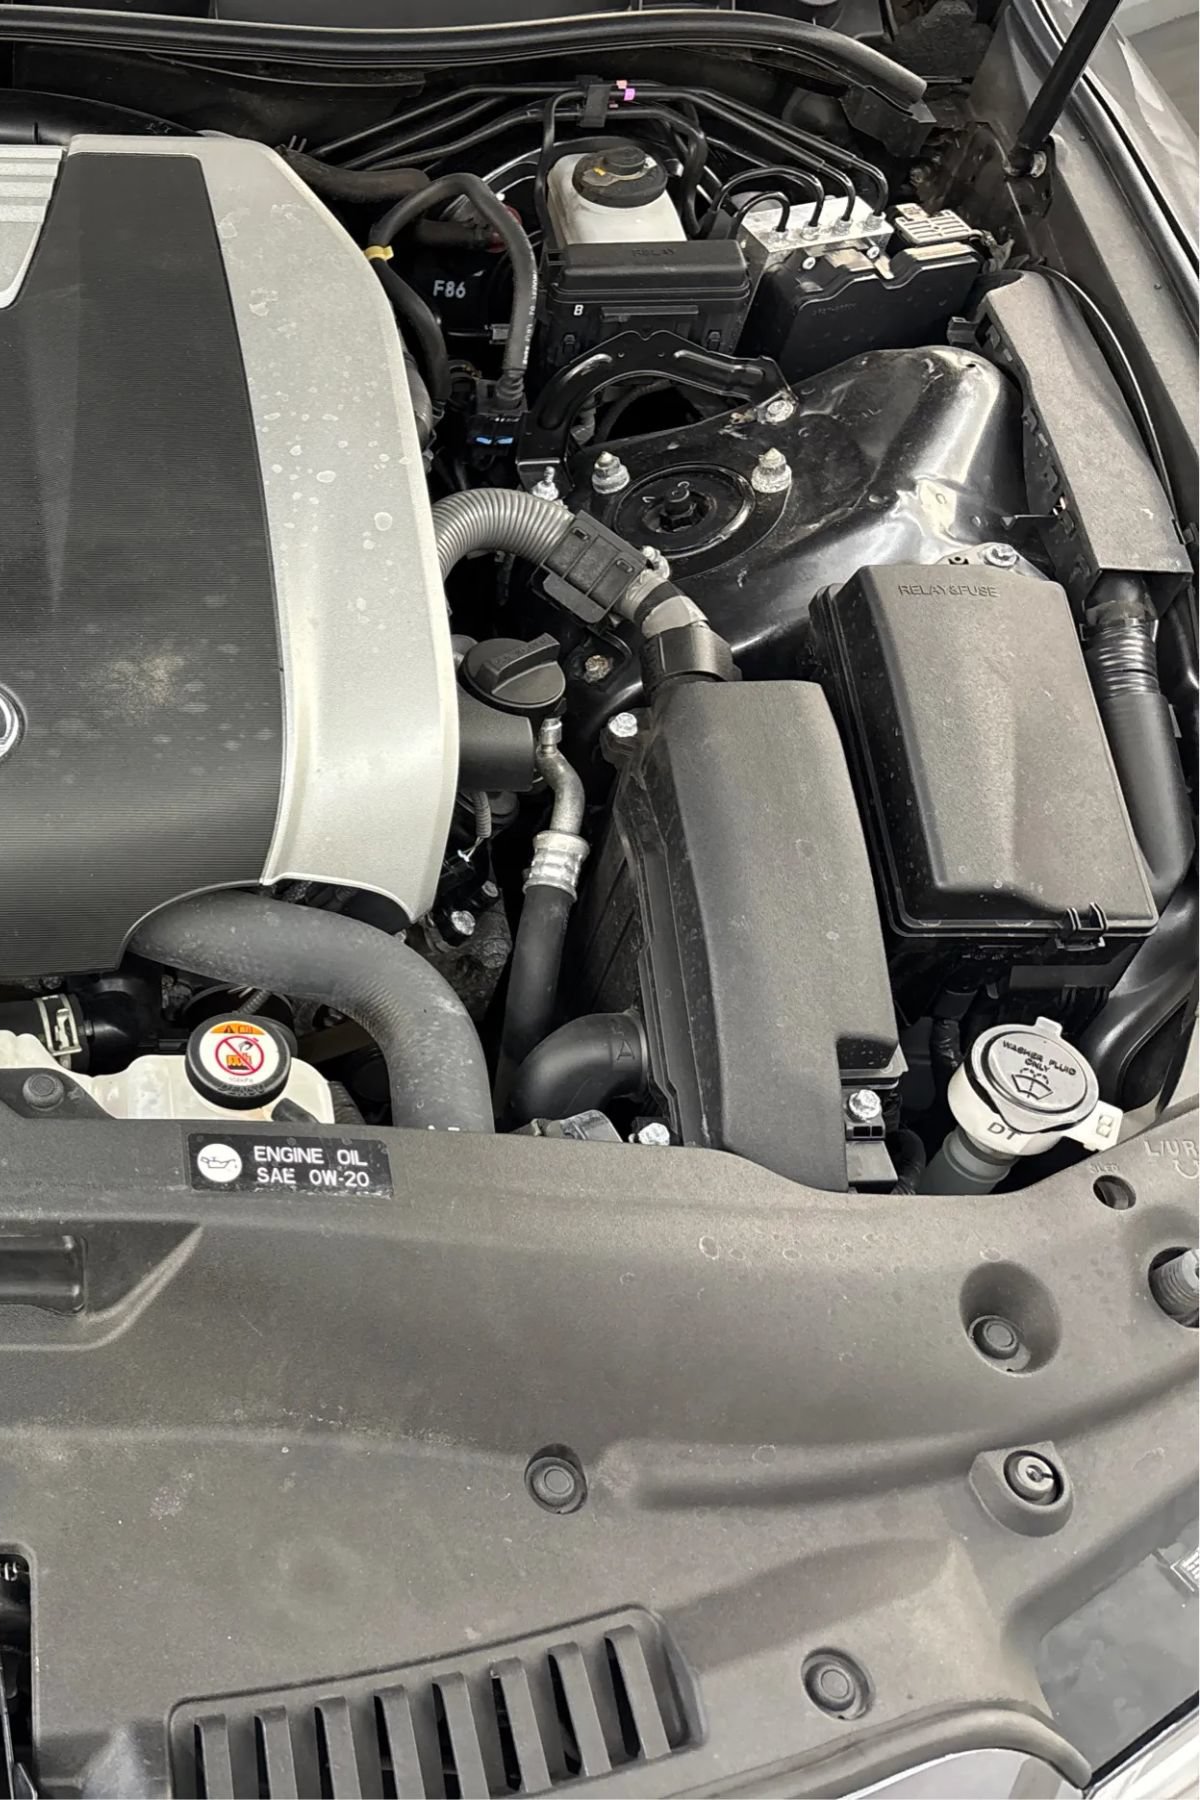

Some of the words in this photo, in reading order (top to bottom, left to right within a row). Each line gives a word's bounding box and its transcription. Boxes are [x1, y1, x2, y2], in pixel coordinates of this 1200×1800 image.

[433, 280, 466, 299] F86
[573, 304, 584, 318] B
[898, 584, 999, 598] RELAY&FUSE
[1003, 1040, 1043, 1062] WASHER
[1049, 1059, 1076, 1076] FLUID
[1025, 1058, 1050, 1072] ONLY
[987, 1121, 1021, 1140] DT
[253, 1145, 324, 1164] ENGINE
[337, 1149, 368, 1166] OIL
[256, 1167, 296, 1184] SAE
[309, 1169, 370, 1187] 0W-20
